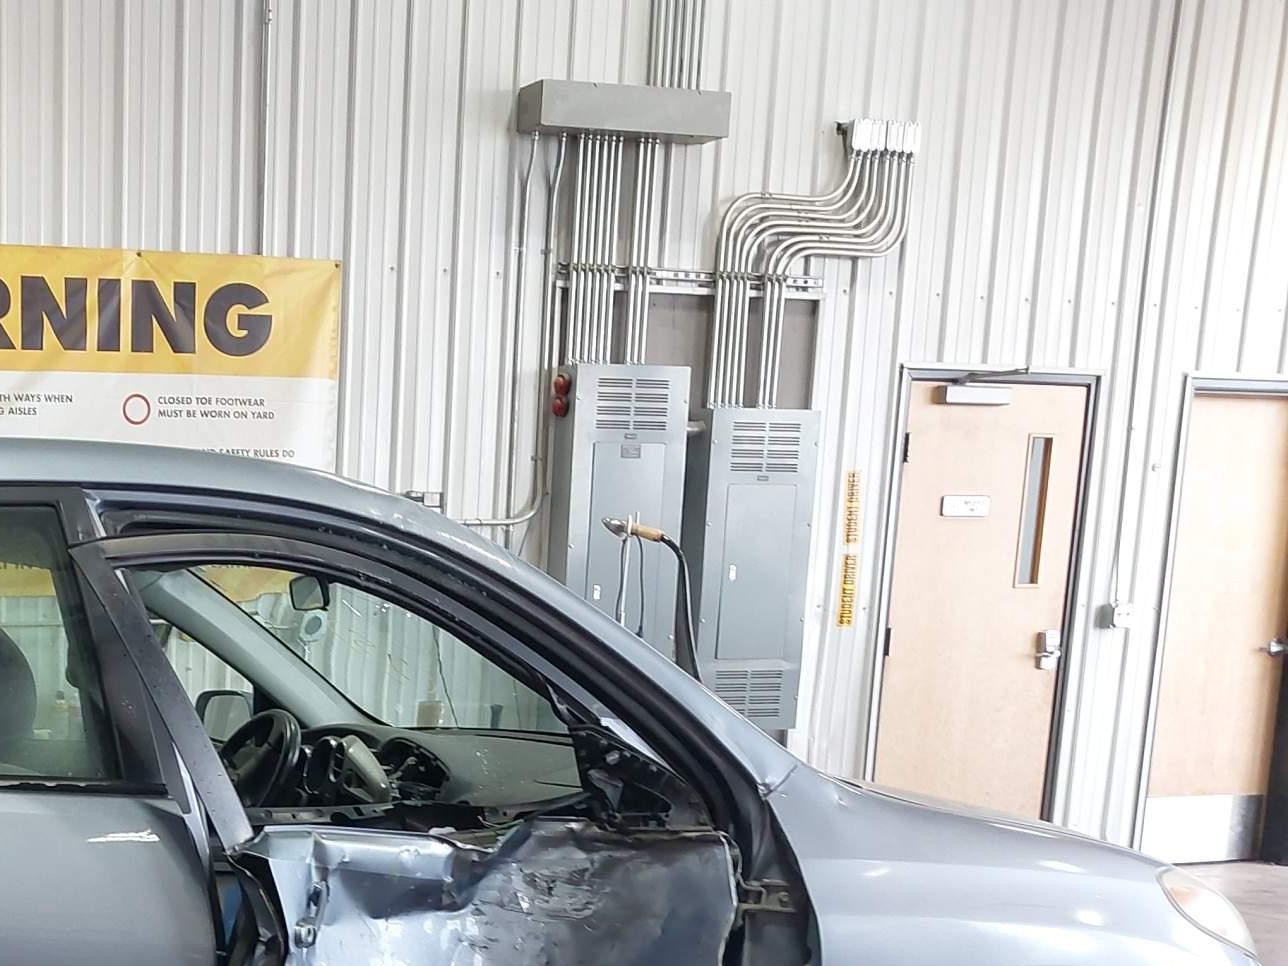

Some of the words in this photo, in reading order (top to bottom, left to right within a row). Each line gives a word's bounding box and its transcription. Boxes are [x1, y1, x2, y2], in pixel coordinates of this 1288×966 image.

[13, 393, 41, 403] WAYS
[44, 394, 73, 403] WHEN
[158, 396, 192, 405] CLOSED
[196, 397, 212, 405] TOE
[216, 398, 265, 407] FOOTWEAR
[8, 407, 37, 416] AISLES
[158, 410, 184, 418] MUST
[186, 410, 197, 418] BE
[200, 410, 230, 419] WORN
[233, 410, 248, 419] ON
[251, 411, 275, 420] YARD
[253, 449, 279, 458] RULES
[282, 449, 295, 458] DO
[839, 588, 852, 625] STUDENT
